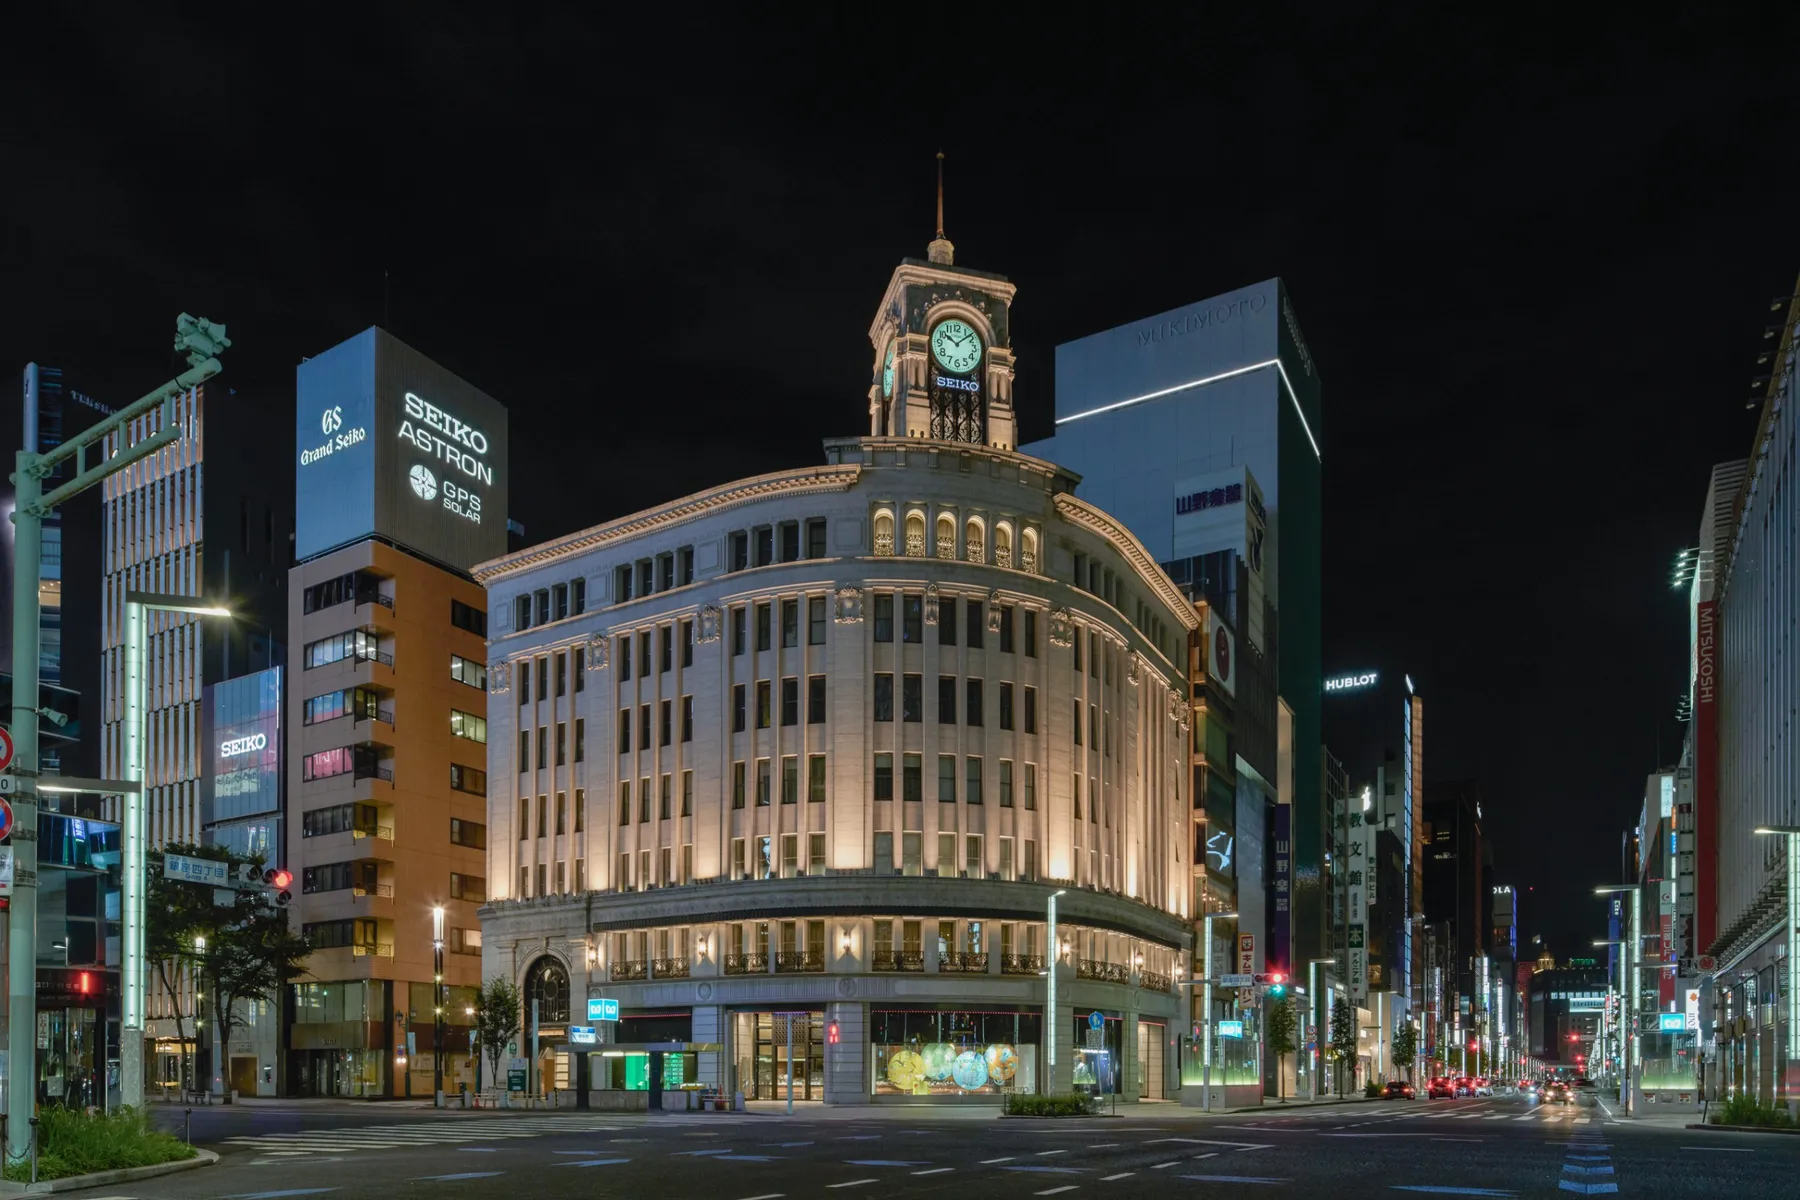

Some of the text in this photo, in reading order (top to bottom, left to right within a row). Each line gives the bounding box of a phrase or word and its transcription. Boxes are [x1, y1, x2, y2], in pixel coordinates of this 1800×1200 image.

[946, 325, 952, 333] 11
[953, 325, 961, 333] 12
[1138, 295, 1266, 346] MIKIMOTO
[936, 376, 979, 392] SEIKO
[322, 405, 343, 435] GS
[405, 392, 488, 454] SEIKO
[300, 426, 366, 466] Grand Seiko
[398, 420, 492, 486] ASTRON
[443, 481, 481, 511] GPS
[443, 497, 481, 524] SOLAR
[1176, 483, 1241, 515] 山野楽器
[1700, 607, 1713, 703] MITSUKOSHI
[1326, 674, 1377, 691] HUBLOT
[221, 733, 267, 758] SEIKO
[1349, 812, 1362, 886] 教文館
[169, 861, 224, 878] 銀座四丁目
[1276, 840, 1288, 912] 山野楽器
